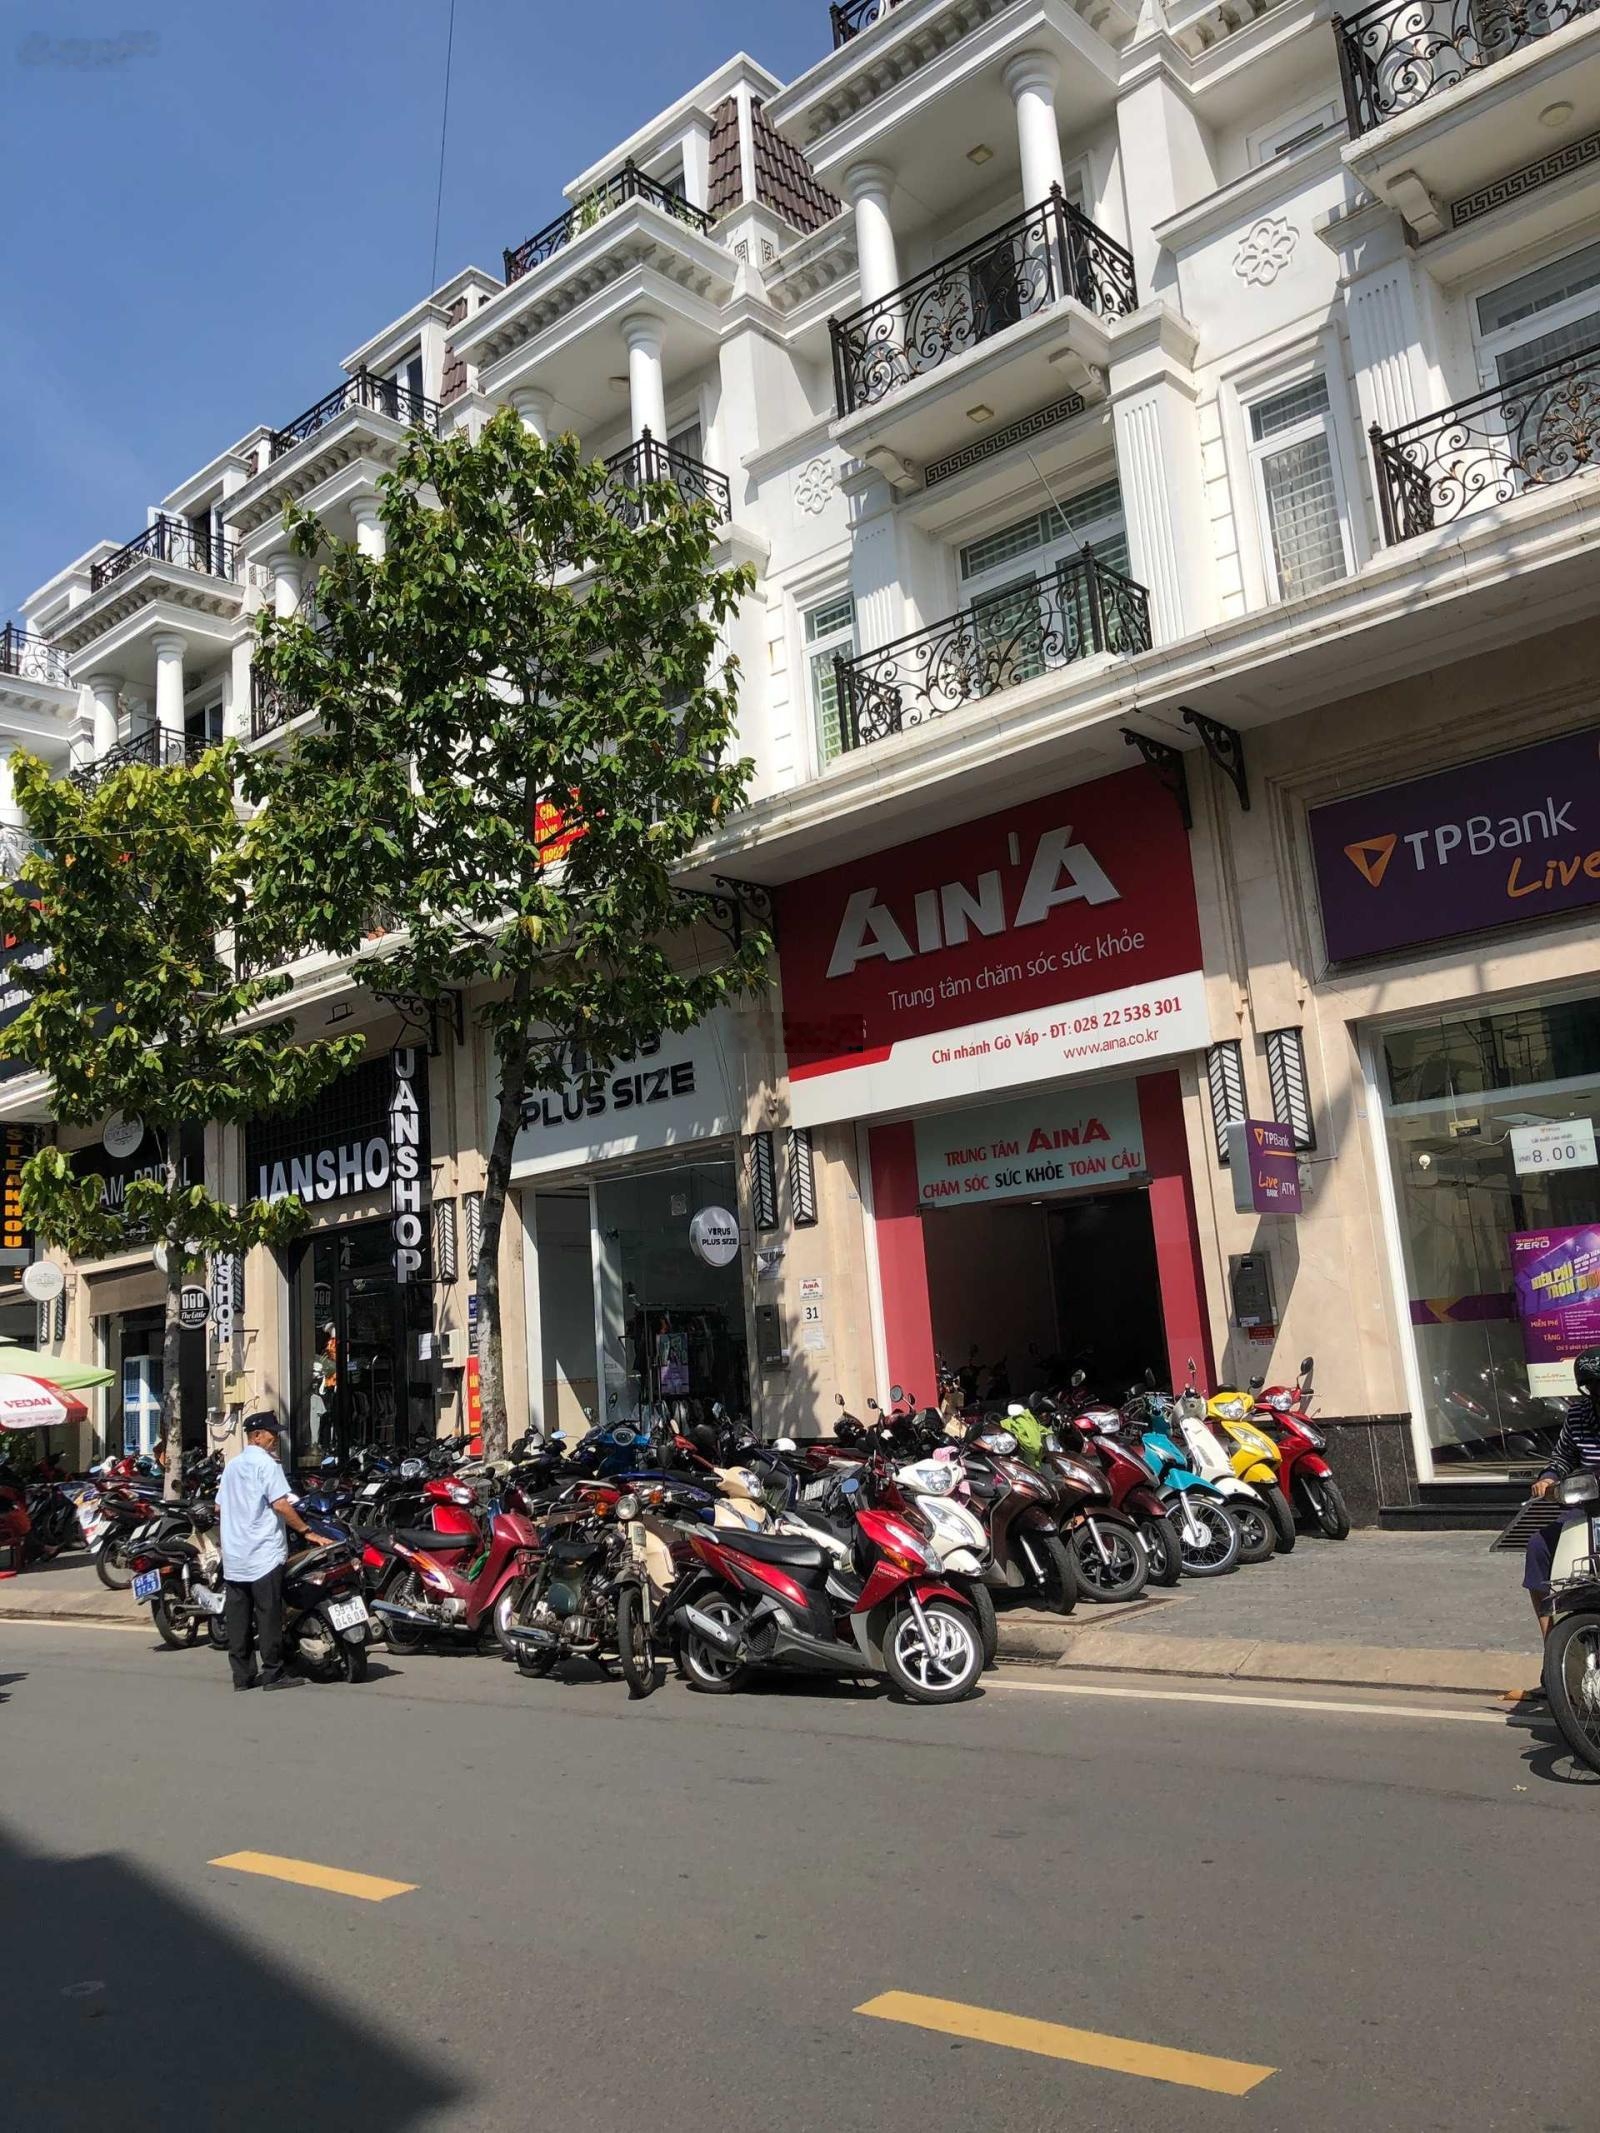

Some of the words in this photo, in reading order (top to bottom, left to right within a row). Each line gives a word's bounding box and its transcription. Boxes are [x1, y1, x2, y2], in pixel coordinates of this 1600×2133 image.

[1404, 797, 1577, 870] TPBank
[1507, 850, 1600, 897] Live
[887, 986, 935, 1011] Trung
[939, 977, 971, 1000] tâm
[976, 963, 1022, 990] chăm
[1027, 952, 1058, 976] sóc
[1062, 942, 1092, 969] sức
[1096, 927, 1145, 958] khỏe
[953, 1041, 991, 1060] nhánh
[994, 1035, 1011, 1051] Gò
[1015, 1027, 1039, 1047] Vấp
[1073, 1016, 1099, 1033] 028
[1103, 1010, 1121, 1027] 22
[1124, 1003, 1151, 1023] 538
[1154, 996, 1183, 1017] 301
[520, 1084, 607, 1131] PLUS
[612, 1061, 697, 1110] SIZE
[1264, 1131, 1290, 1148] TPBank
[944, 1146, 987, 1167] TRUNG
[991, 1140, 1020, 1159] TÂM
[1533, 1145, 1576, 1163] 8.00
[392, 1048, 422, 1284] JANSHOP
[922, 1179, 960, 1199] CHĂM
[964, 1173, 990, 1193] SÓC
[995, 1166, 1022, 1189] SỨC
[1026, 1160, 1065, 1183] KHỎE
[1068, 1155, 1107, 1177] TOÀN
[1111, 1147, 1142, 1170] CẦU
[1259, 1170, 1279, 1189] Live
[1281, 1182, 1296, 1196] ATM
[702, 1238, 720, 1246] PLUS
[722, 1237, 738, 1245] SIZE
[1516, 1240, 1550, 1251] ZERO
[806, 1306, 819, 1320] 31
[3, 1397, 52, 1409] VEDAN
